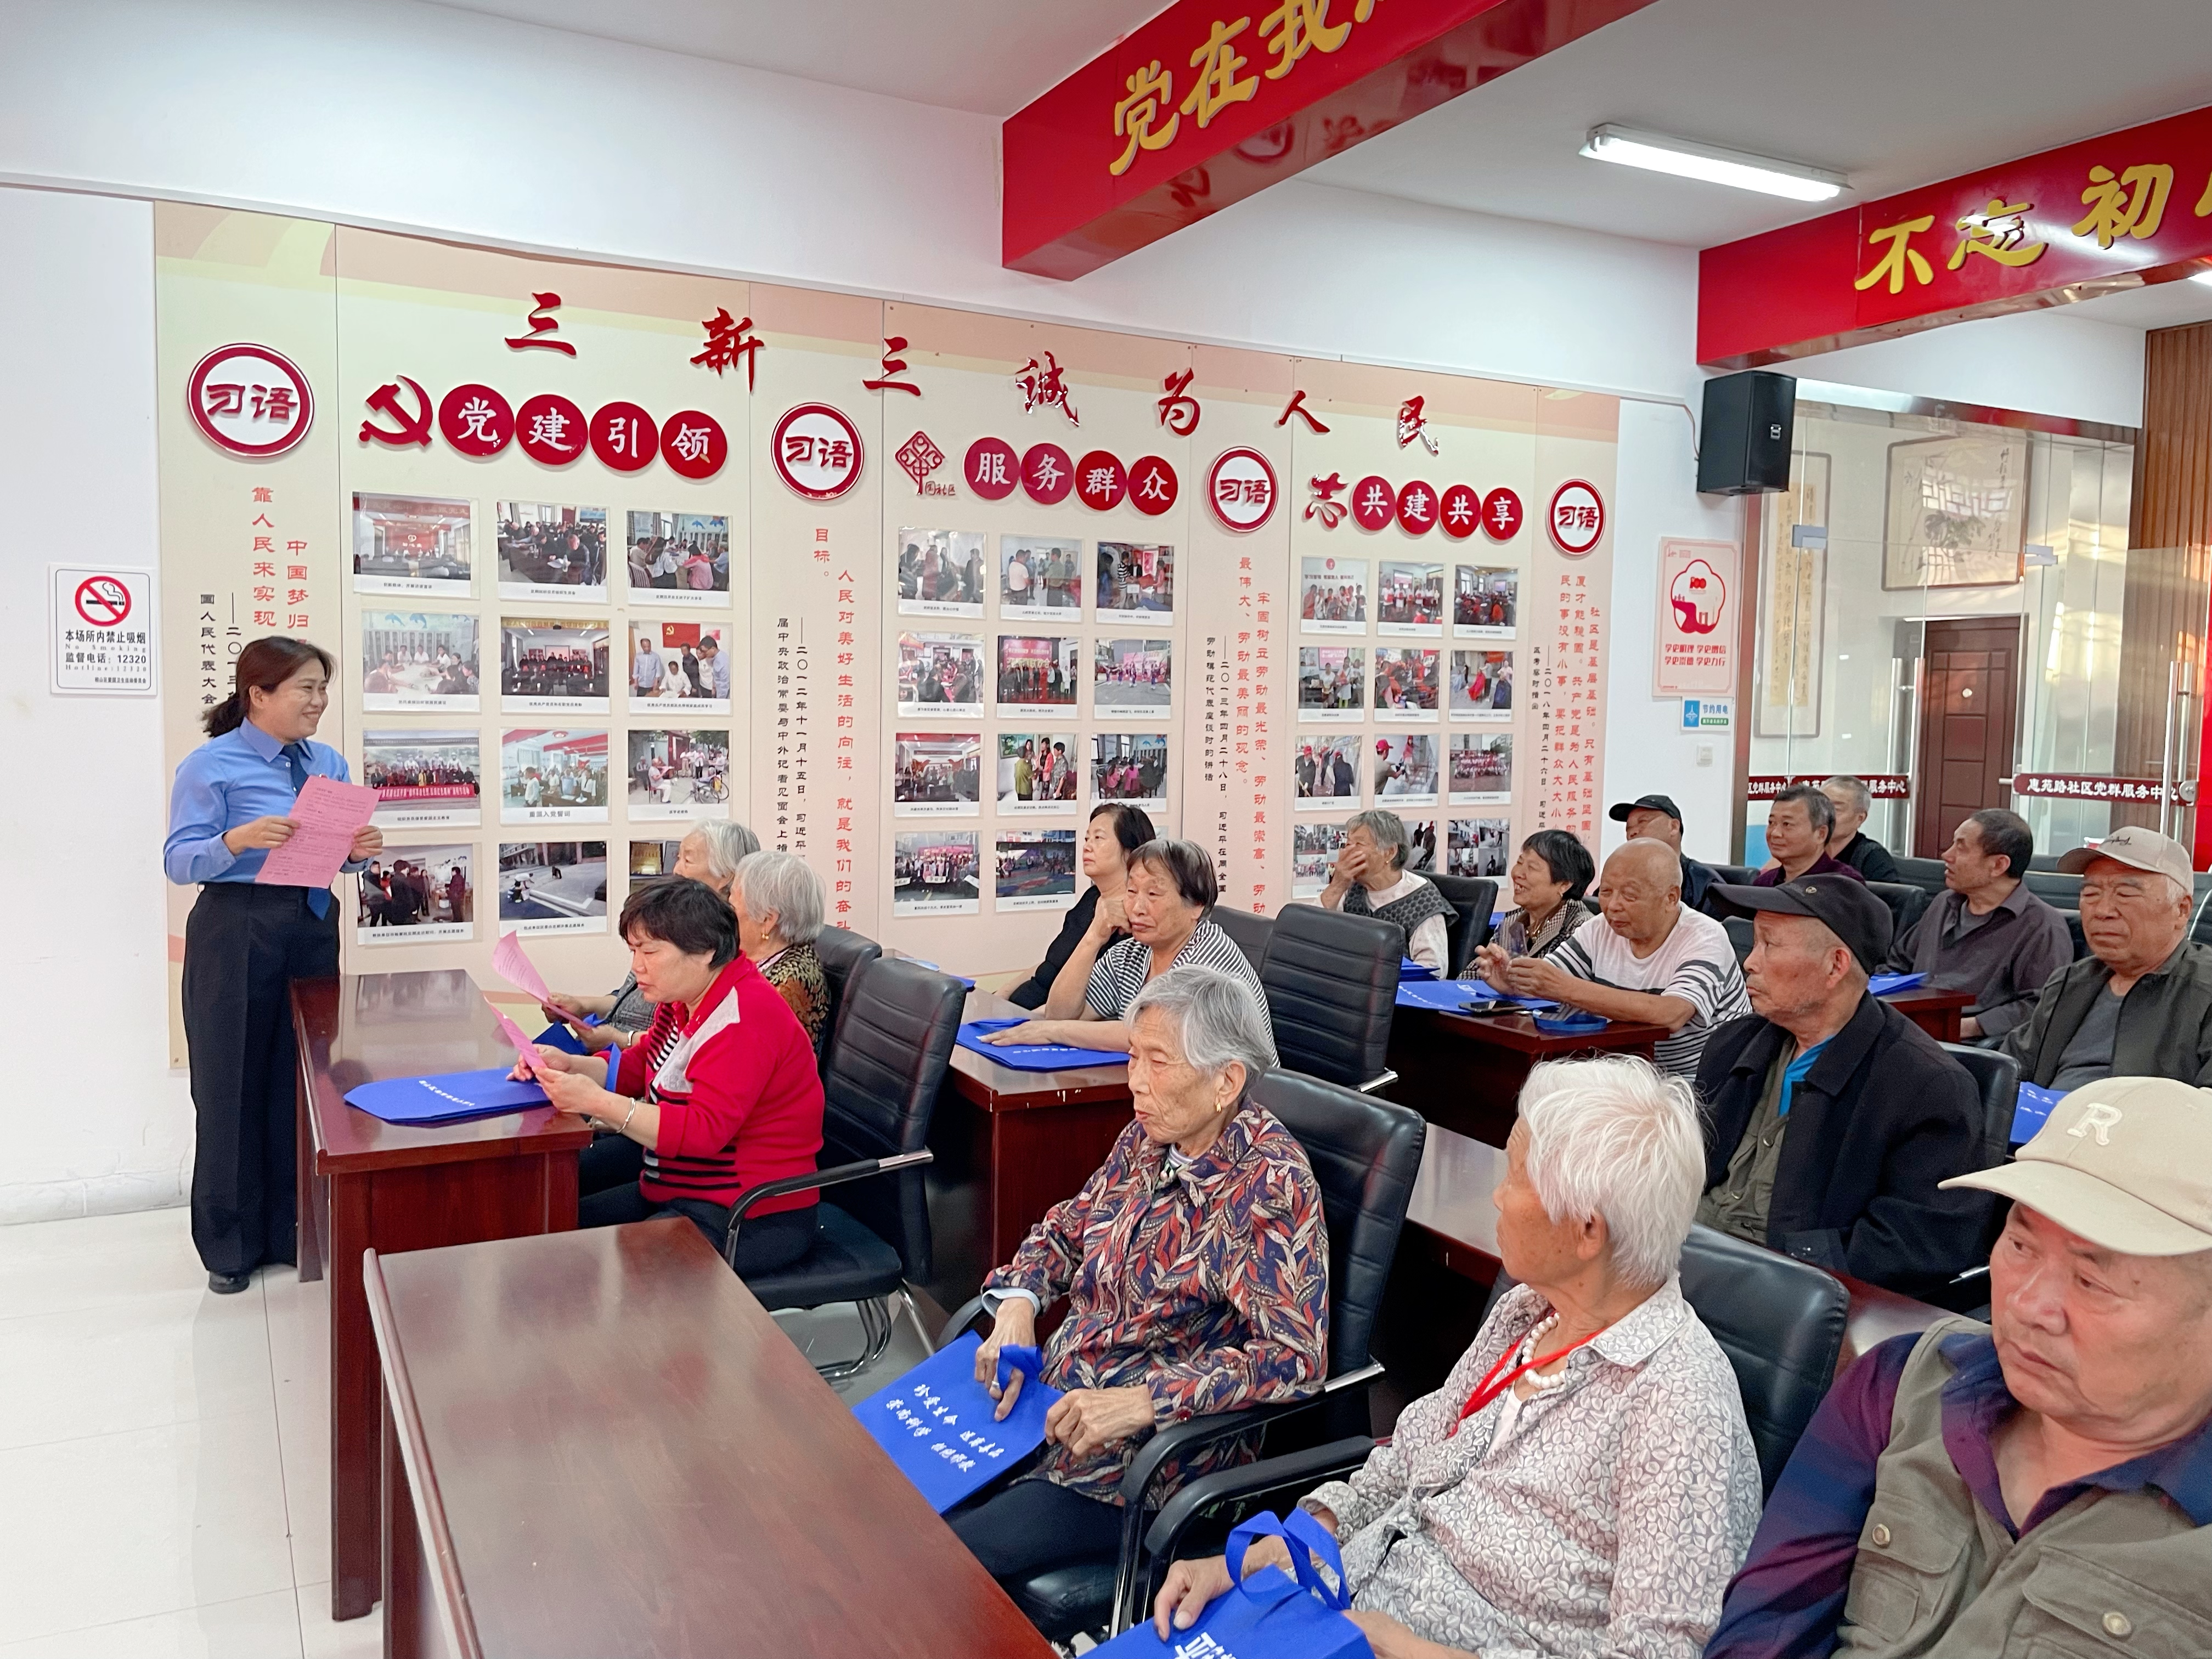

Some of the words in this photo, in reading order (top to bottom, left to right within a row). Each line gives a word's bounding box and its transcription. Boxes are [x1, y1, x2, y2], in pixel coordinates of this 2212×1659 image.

[1110, 0, 1385, 176] 党在我
[1854, 164, 2212, 294] 不忘初
[206, 385, 298, 421] 习语
[458, 396, 710, 460] 党建引领
[786, 436, 853, 468] 习语
[976, 453, 1170, 502] 服务群众
[1219, 479, 1271, 505] 习语
[1361, 483, 1515, 531] 共建共享
[1559, 506, 1598, 529] 习语
[252, 487, 276, 627] 靠人民来实现
[814, 529, 830, 577] 目标。
[287, 540, 309, 644] 中国梦归
[65, 629, 145, 644] 本场所内禁止吸烟
[117, 655, 146, 663] 12320
[200, 594, 217, 704] 国人民代表大会
[1703, 704, 1728, 714] 节约用电
[2067, 1103, 2123, 1146] R
